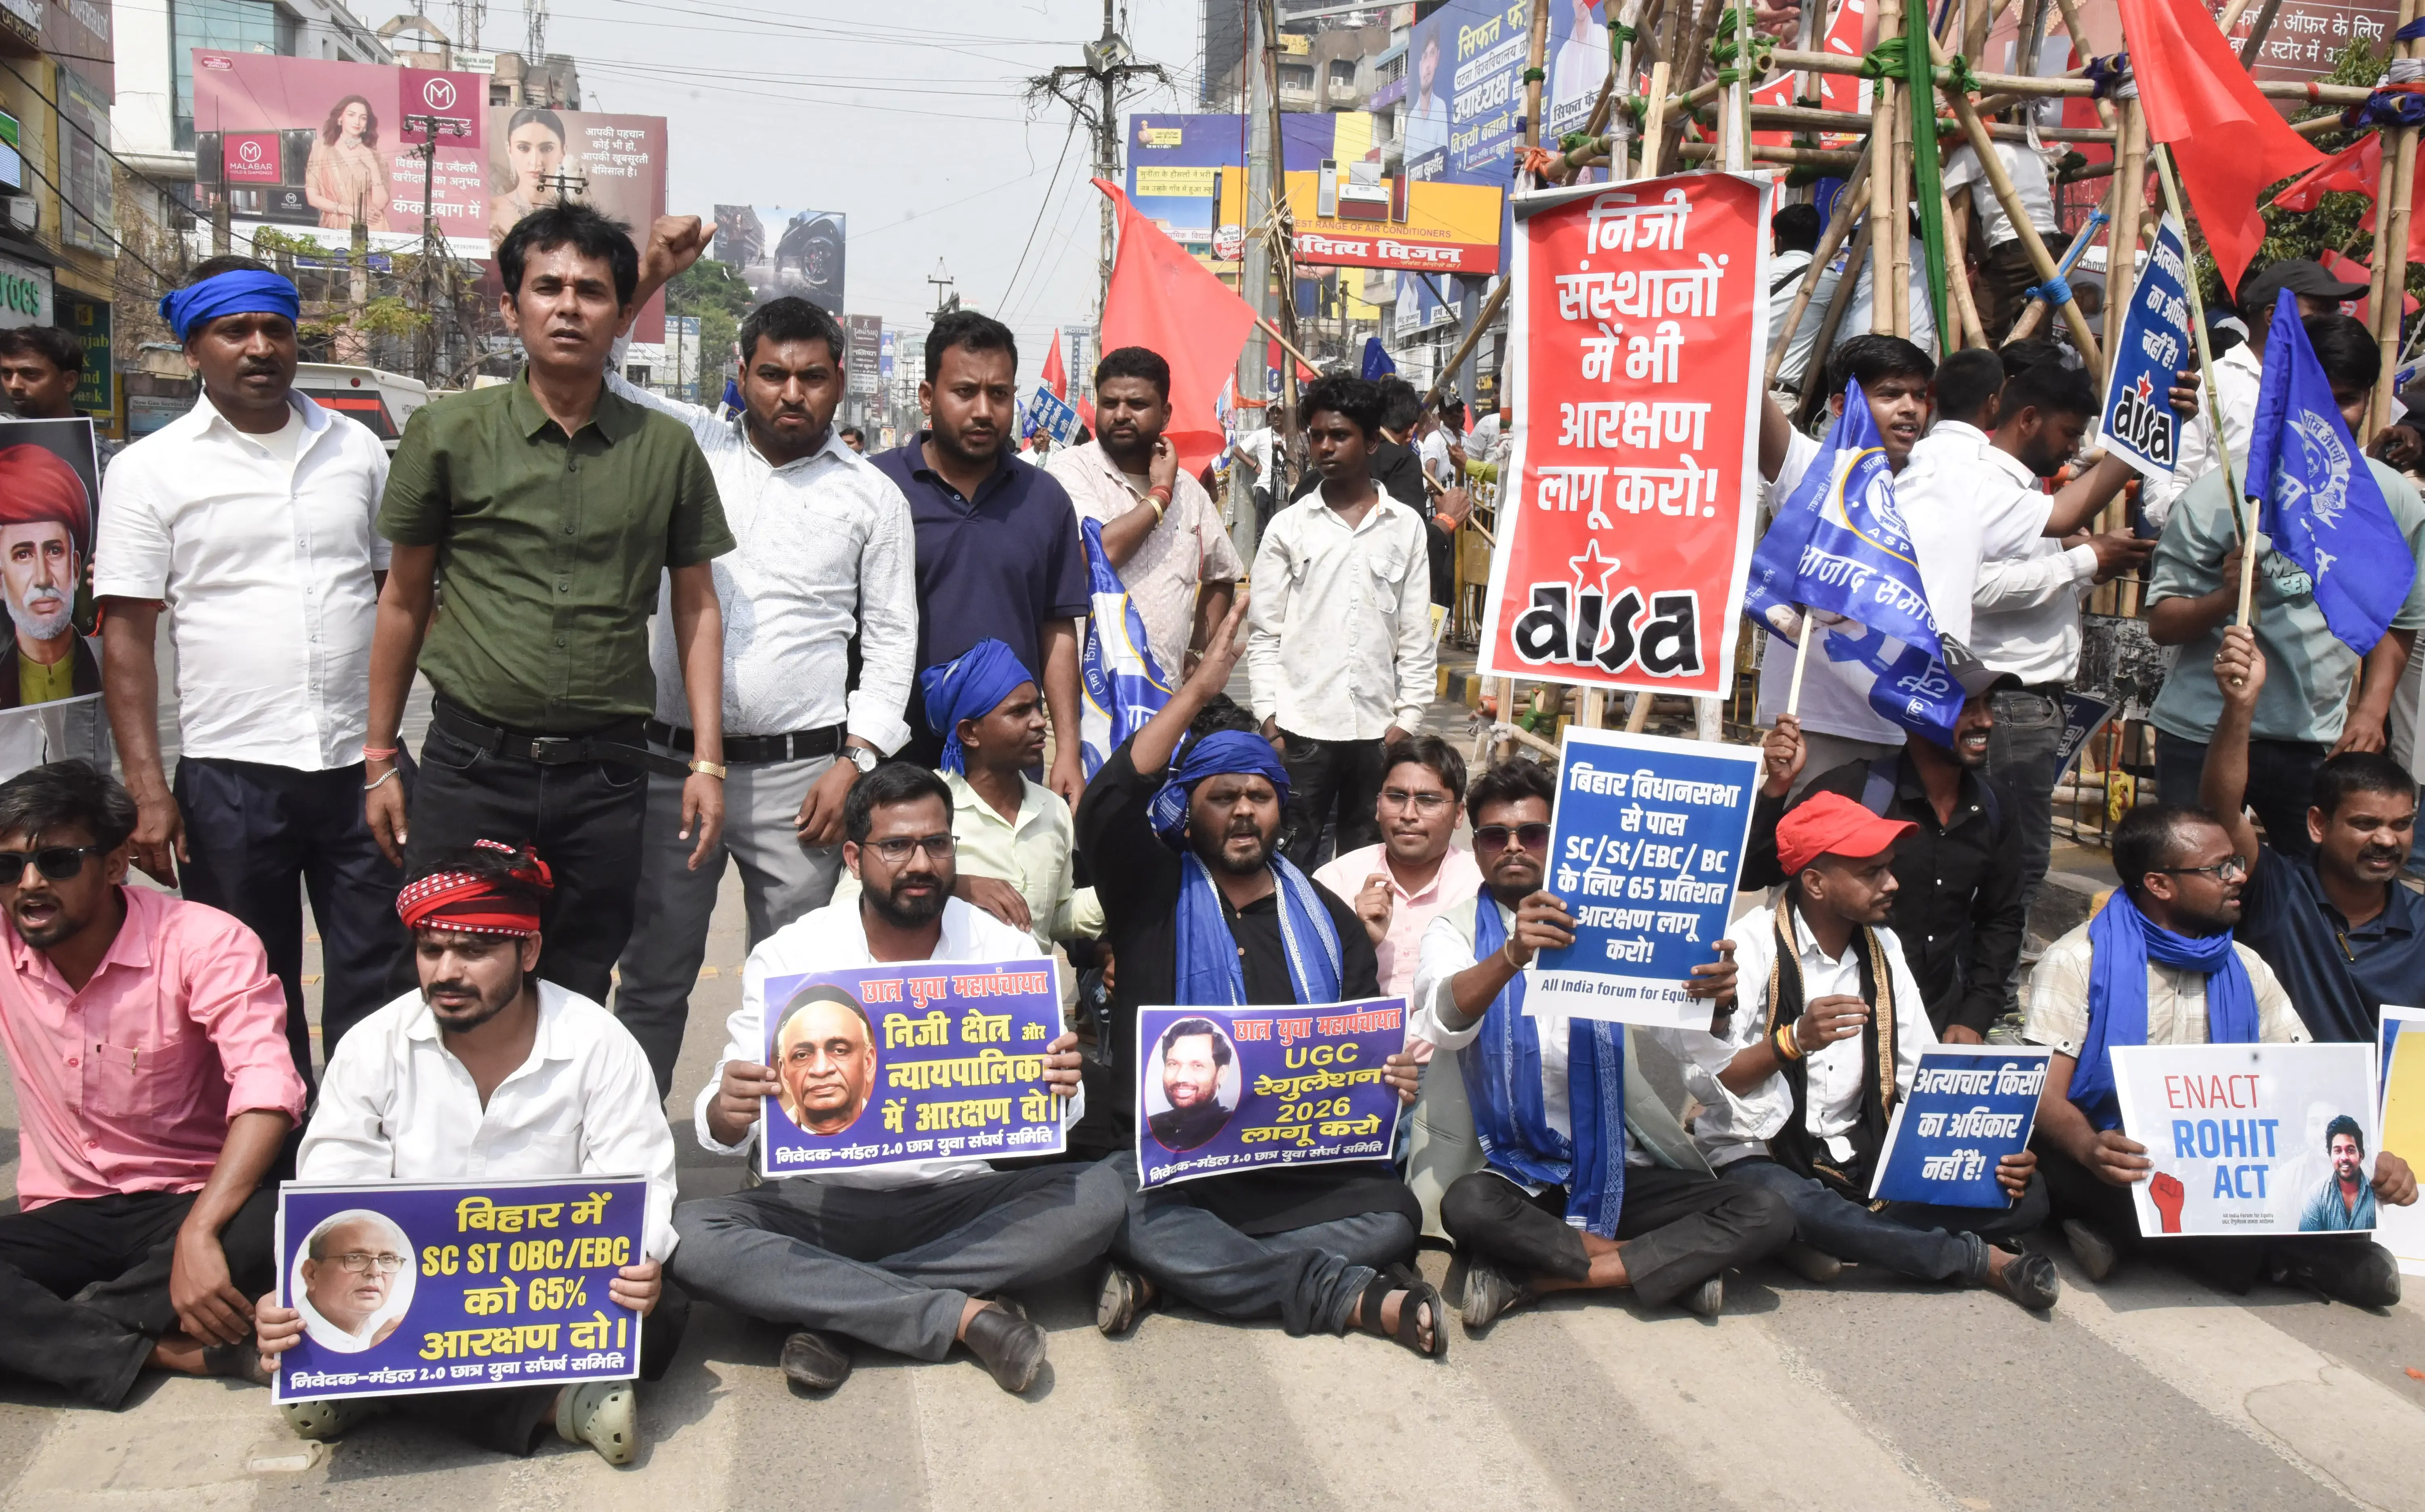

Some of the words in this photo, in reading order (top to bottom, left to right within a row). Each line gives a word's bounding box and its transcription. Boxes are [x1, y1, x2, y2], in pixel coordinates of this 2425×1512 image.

[2332, 13, 2348, 36] के
[2353, 15, 2385, 41] लिए
[2271, 36, 2302, 61] स्टोर
[2307, 39, 2320, 62] में
[586, 126, 614, 137] आपकी
[617, 130, 645, 139] पहचान
[593, 139, 609, 151] कोई
[612, 139, 623, 150] भी
[581, 151, 610, 161] आपकी
[612, 153, 648, 166] खूबसूरती
[591, 164, 625, 176] बेमिसाल
[450, 177, 481, 189] अनुभव
[468, 199, 481, 219] में
[1587, 188, 1692, 253] निजी
[1316, 221, 1347, 231] RANGE
[1351, 223, 1362, 232] OF
[1365, 224, 1380, 233] AIR
[1383, 225, 1451, 238] CONDITIONERS
[1376, 240, 1463, 263] विजन
[1555, 253, 1729, 321] संस्थानों
[2146, 284, 2164, 314] का
[1581, 324, 1622, 383] में
[1626, 321, 1685, 383] भी
[1558, 402, 1711, 451] आरक्षण
[2112, 385, 2172, 465] aisa
[1537, 465, 1614, 530] लागू
[1614, 454, 1719, 518] करो!
[1512, 584, 1702, 677] aisa
[1569, 762, 1629, 796] बिहार
[1631, 769, 1741, 808] विधानसभा
[1620, 803, 1644, 832] से
[1646, 810, 1689, 836] पास
[1700, 850, 1729, 873] BC
[1557, 863, 1580, 893] के
[1583, 866, 1625, 897] लिए
[1627, 876, 1655, 900] 65
[1658, 874, 1728, 905] प्रतिशत
[1577, 905, 1655, 932] आरक्षण
[1656, 912, 1700, 942] लागू
[1606, 936, 1655, 964] करो!
[908, 977, 948, 1009] युवा
[951, 967, 1048, 998] महापंचायत
[1541, 978, 1558, 991] All
[1561, 979, 1594, 994] India
[1598, 982, 1636, 999] forum
[1641, 987, 1659, 1000] for
[882, 1011, 951, 1049] निजी
[961, 1009, 1012, 1044] क्षेत्र
[1022, 1022, 1046, 1040] और
[1277, 1018, 1312, 1046] युवा
[1318, 1007, 1402, 1036] महापंचायत
[1285, 1042, 1359, 1068] UGC
[1253, 1068, 1383, 1101] रेगुलेशन
[1914, 1068, 1996, 1095] अत्याचार
[1995, 1063, 2045, 1095] किसी
[2164, 1075, 2260, 1109] ENACT
[882, 1097, 909, 1133] में
[915, 1097, 1012, 1132] आरक्षण
[1276, 1096, 1350, 1123] 2026
[1917, 1112, 1948, 1137] का
[1946, 1106, 2024, 1138] अधिकार
[881, 1142, 902, 1156] 2.0
[906, 1139, 934, 1154] छात्र
[937, 1137, 965, 1156] युवा
[968, 1131, 1004, 1149] संघर्ष
[1006, 1127, 1053, 1146] समिति
[1241, 1123, 1316, 1147] लागू
[1319, 1114, 1382, 1136] करो
[2172, 1119, 2279, 1158] ROHIT
[1233, 1153, 1251, 1163] 2.0
[1255, 1150, 1279, 1161] छात्र
[1282, 1149, 1307, 1162] युवा
[1310, 1143, 1341, 1156] संघर्ष
[1343, 1140, 1383, 1155] समिति
[1922, 1149, 1963, 1180] नहीं
[1963, 1149, 1986, 1180] है!
[2213, 1165, 2269, 1199] ACT
[455, 1196, 565, 1232] बिहार
[571, 1192, 613, 1224] में
[422, 1244, 460, 1277] SC
[467, 1242, 502, 1274] ST
[508, 1236, 630, 1272] OBC/EBC
[464, 1276, 520, 1316] को
[529, 1276, 586, 1311] 65%
[419, 1324, 560, 1360] आरक्षण
[420, 1367, 445, 1380] 2.0
[450, 1364, 483, 1379] छात्र
[488, 1362, 520, 1382] युवा
[525, 1354, 567, 1373] संघर्ष
[571, 1353, 626, 1371] समिति
